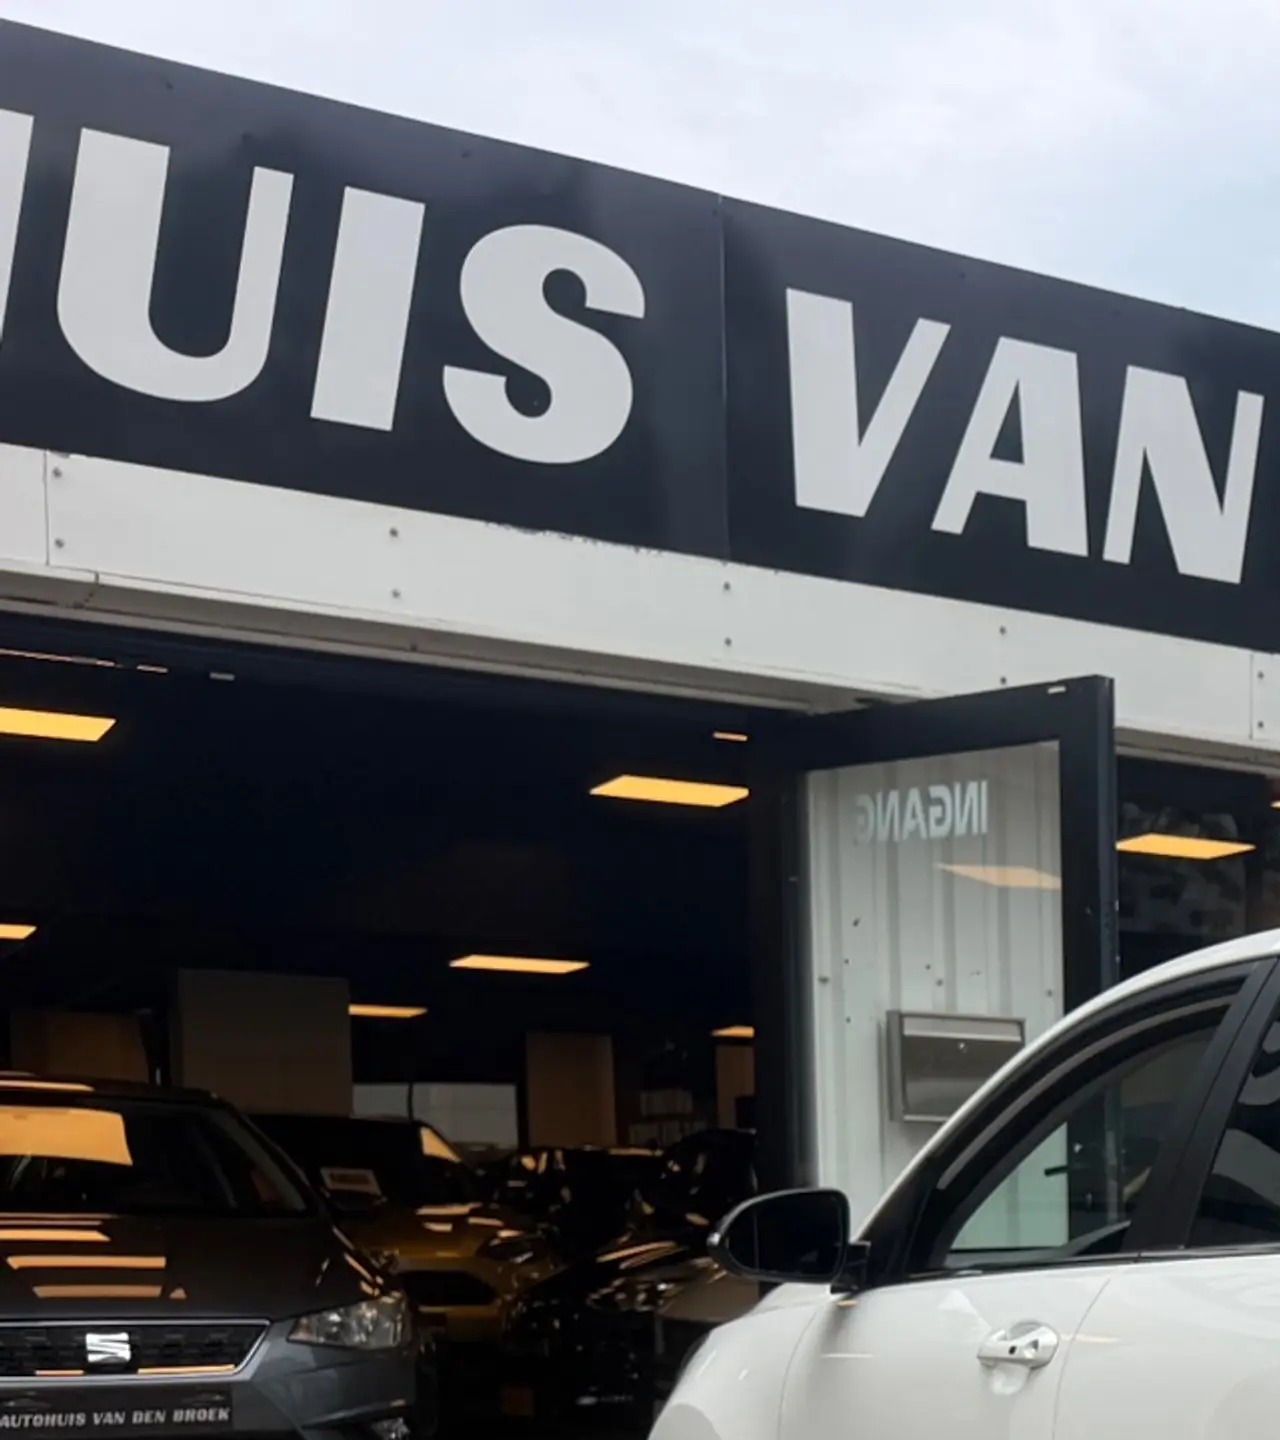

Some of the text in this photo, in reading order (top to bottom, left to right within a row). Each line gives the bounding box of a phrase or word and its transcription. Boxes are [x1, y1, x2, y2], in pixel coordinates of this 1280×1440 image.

[0, 108, 646, 466] UIS
[785, 287, 1265, 585] VAN
[0, 1406, 231, 1429] AUTOHUIS VAN DEN BROEK
